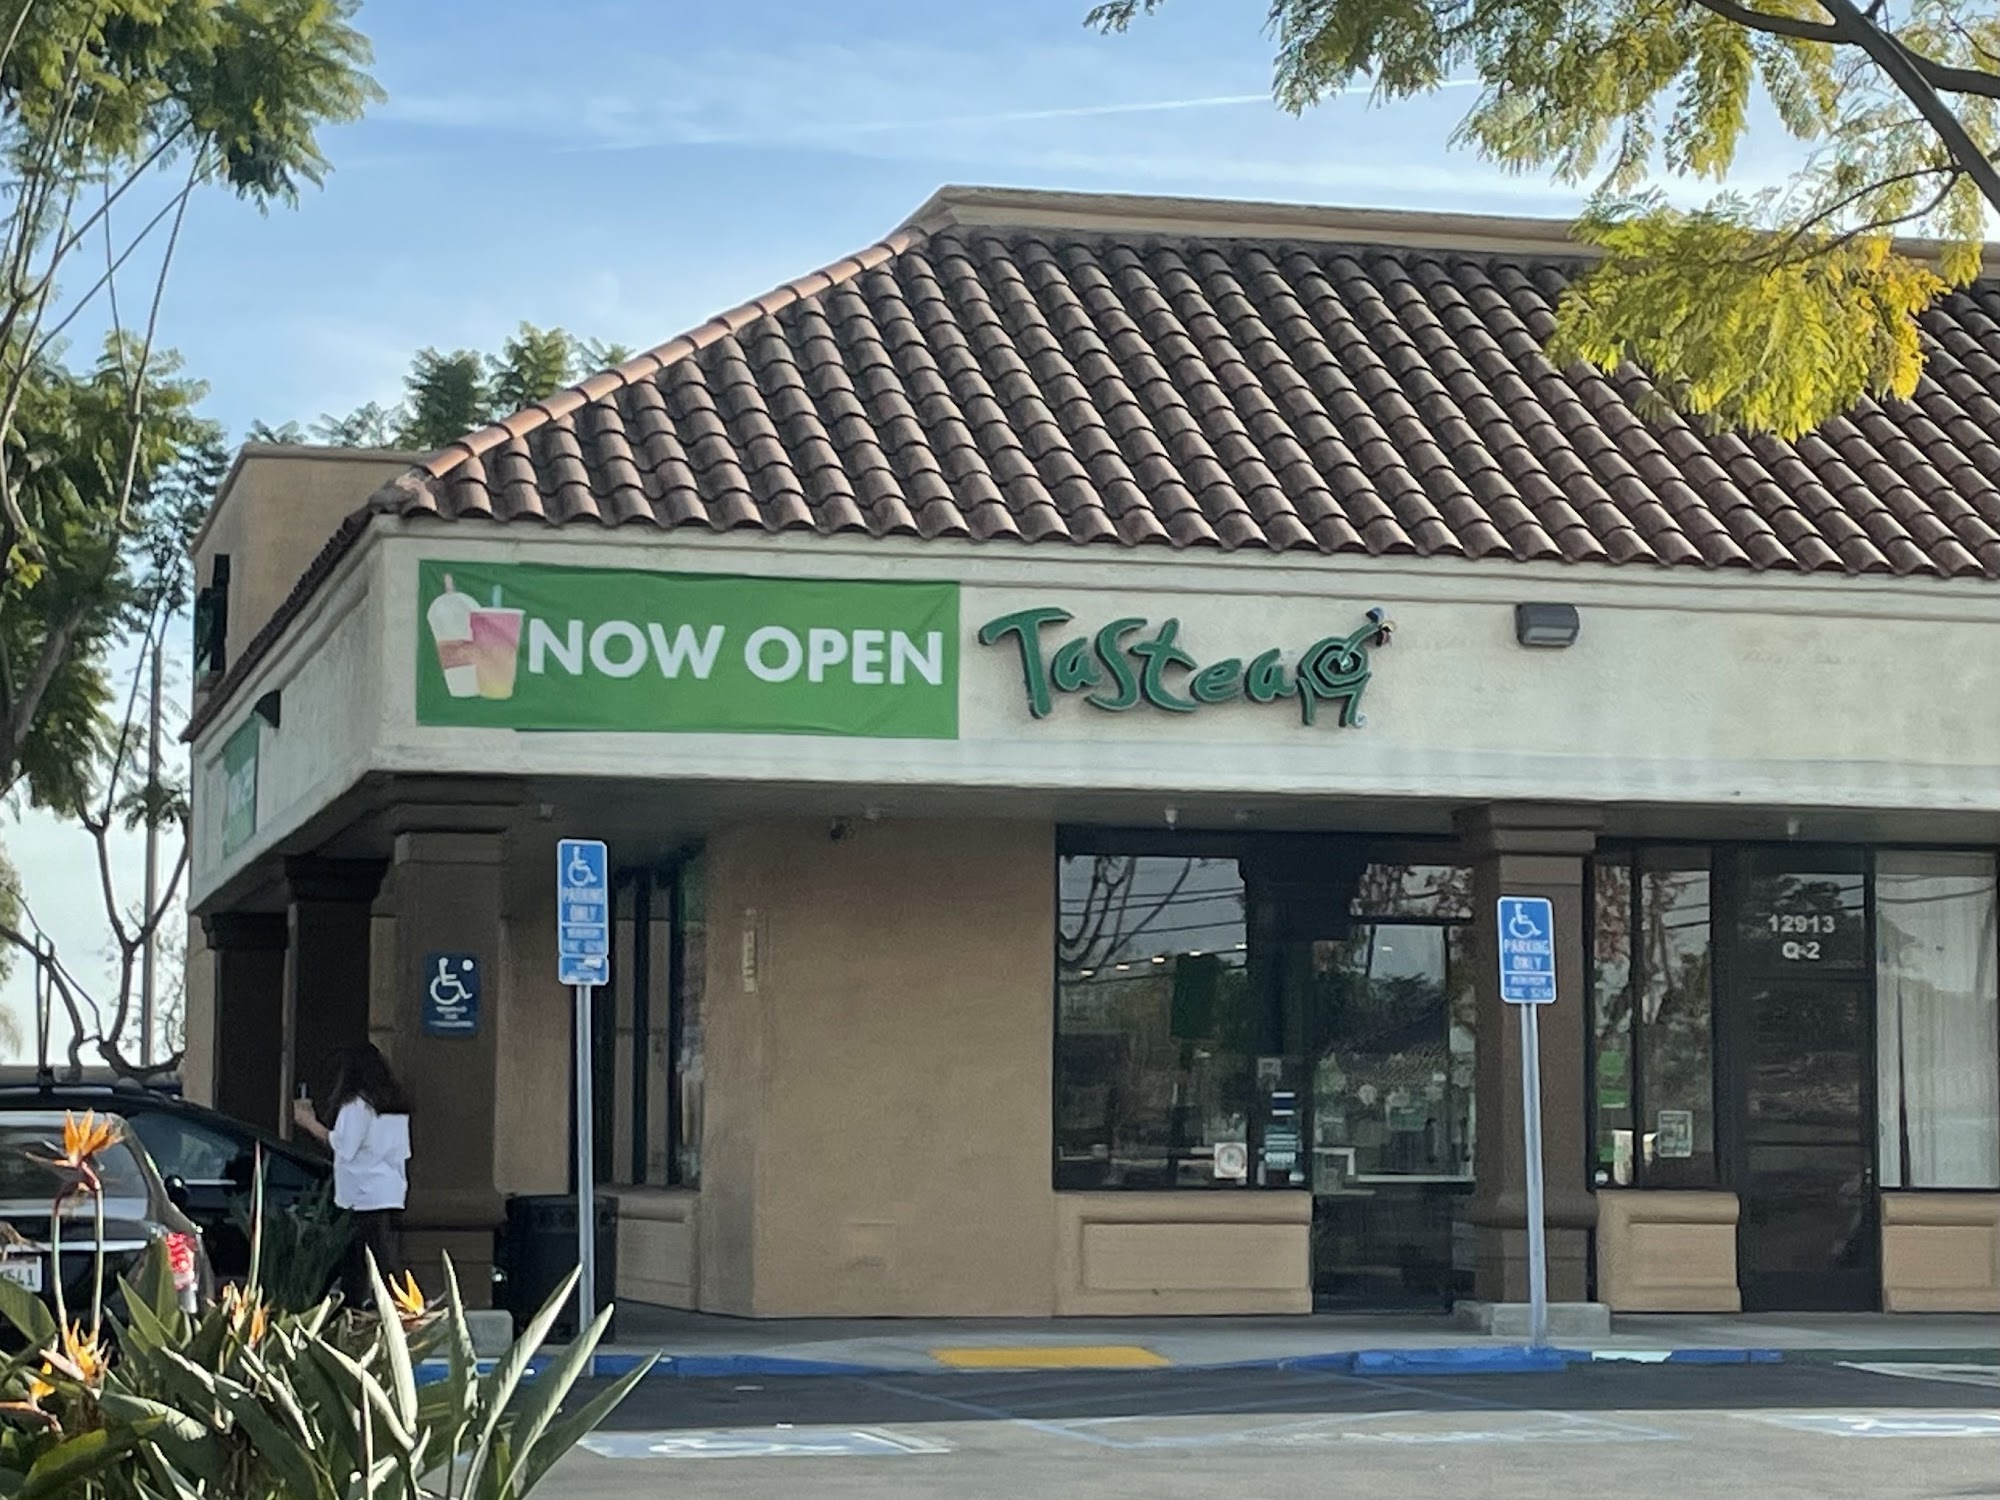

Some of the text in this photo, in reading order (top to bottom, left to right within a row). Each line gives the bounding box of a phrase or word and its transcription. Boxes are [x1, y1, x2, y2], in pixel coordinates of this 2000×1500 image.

[528, 619, 943, 685] NOW OPEN
[1768, 914, 1835, 933] 12913
